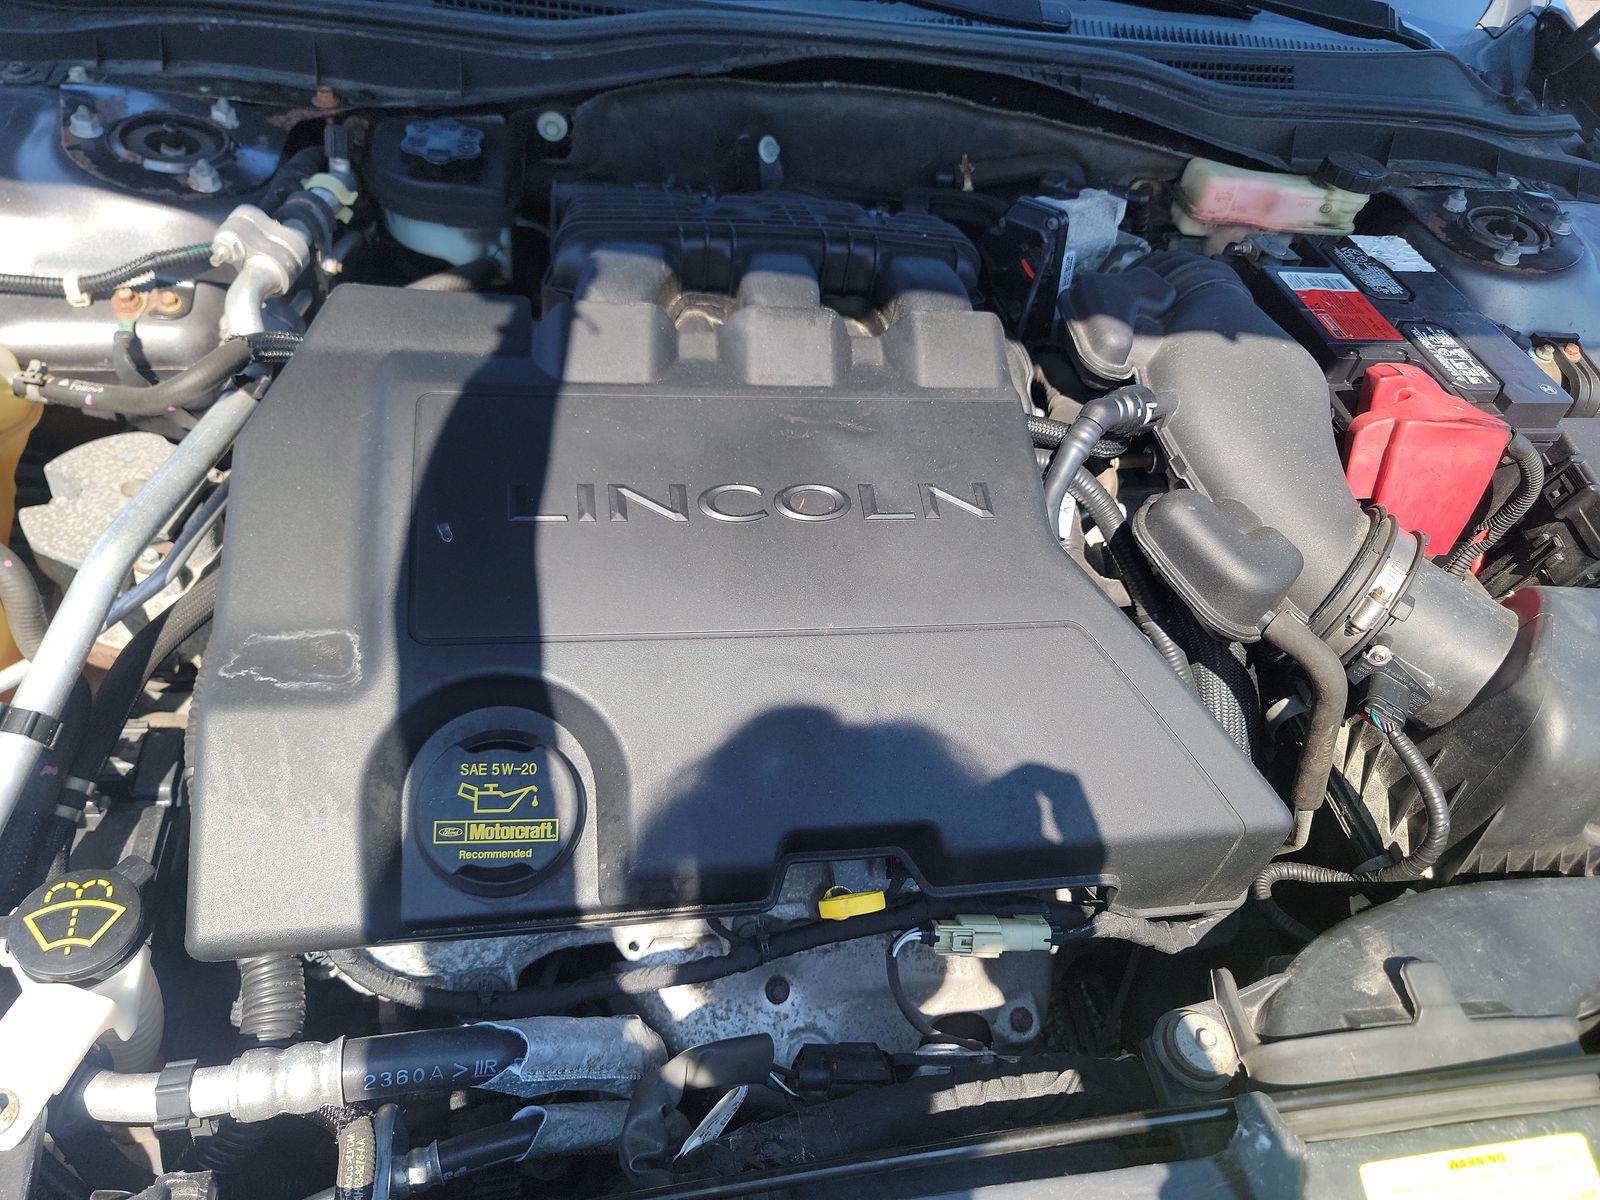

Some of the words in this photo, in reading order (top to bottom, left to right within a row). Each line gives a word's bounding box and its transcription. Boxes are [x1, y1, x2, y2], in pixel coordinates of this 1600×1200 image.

[507, 481, 997, 523] LINCOLN
[460, 762, 488, 776] SAE
[491, 762, 538, 776] 5W-20
[458, 848, 533, 860] Recommended
[1448, 1152, 1507, 1170] WARNING
